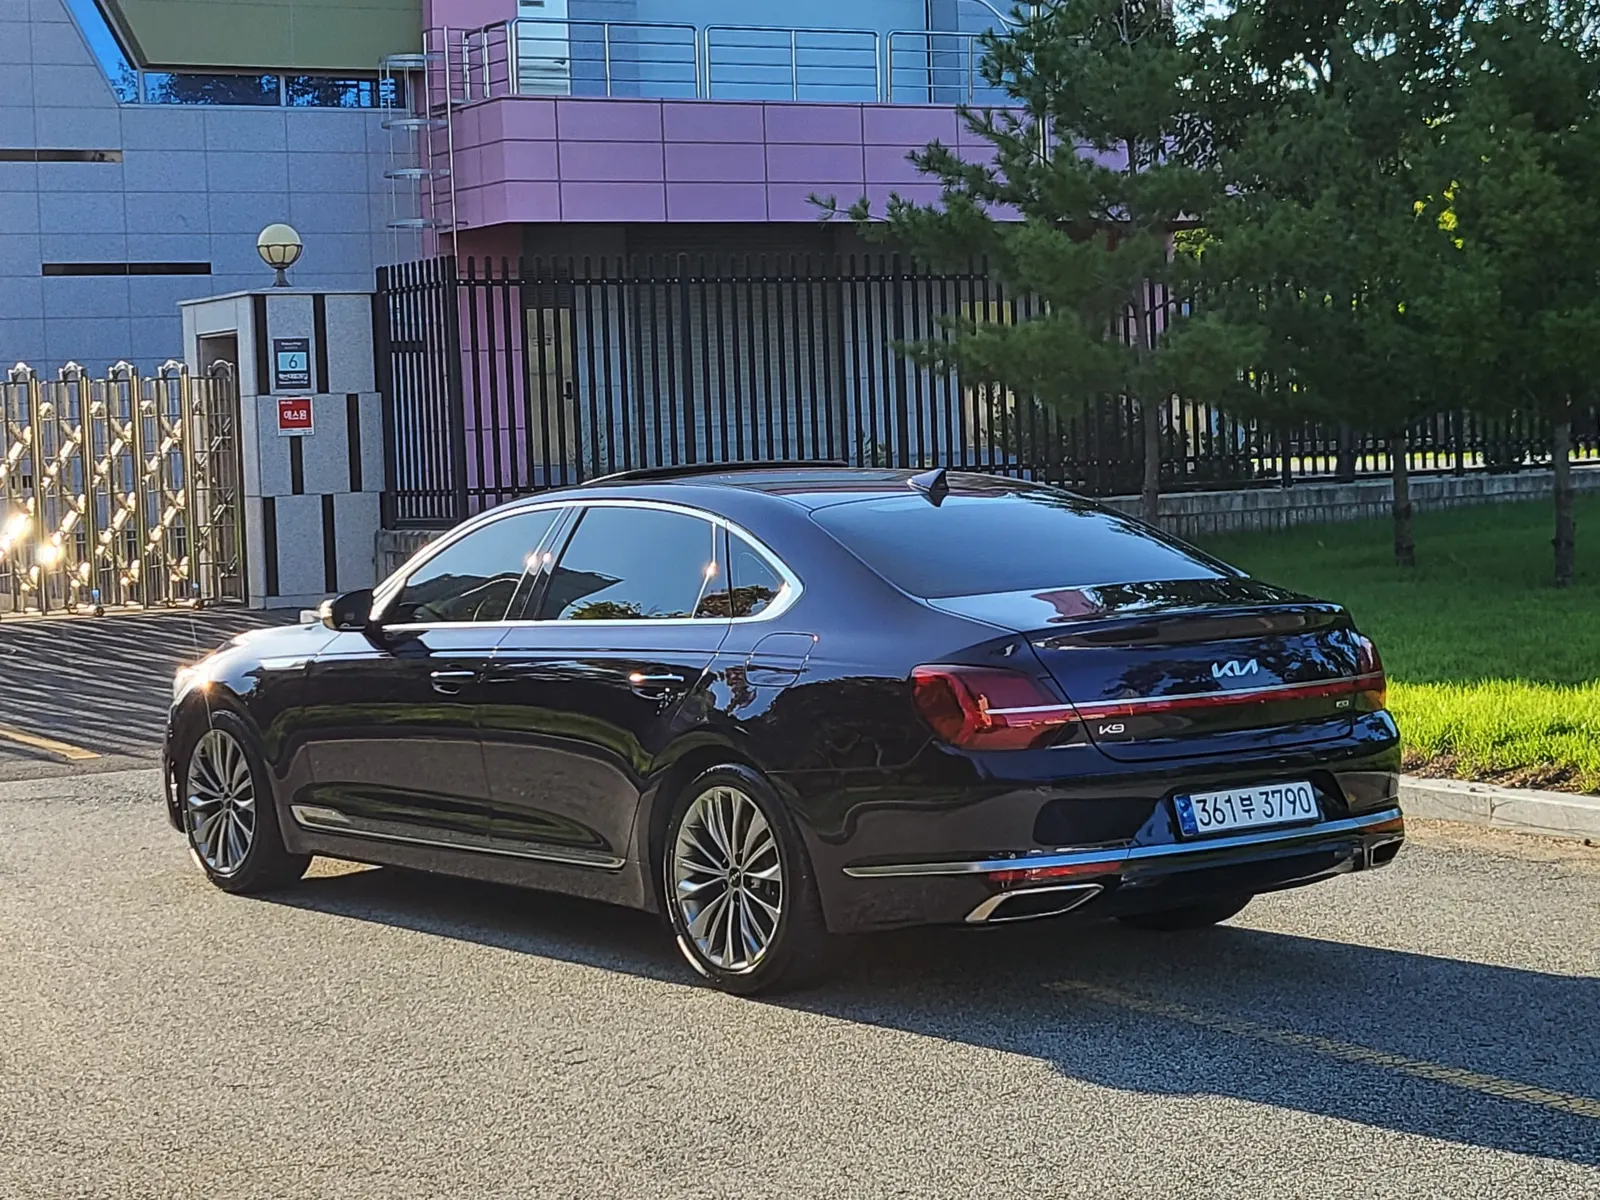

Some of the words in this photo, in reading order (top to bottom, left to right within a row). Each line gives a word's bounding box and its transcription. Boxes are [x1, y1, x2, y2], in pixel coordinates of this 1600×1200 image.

[289, 354, 298, 369] 6
[1211, 658, 1258, 679] KIA
[1098, 723, 1125, 735] K9
[1195, 794, 1256, 827] 361부
[1259, 786, 1312, 819] 3790
